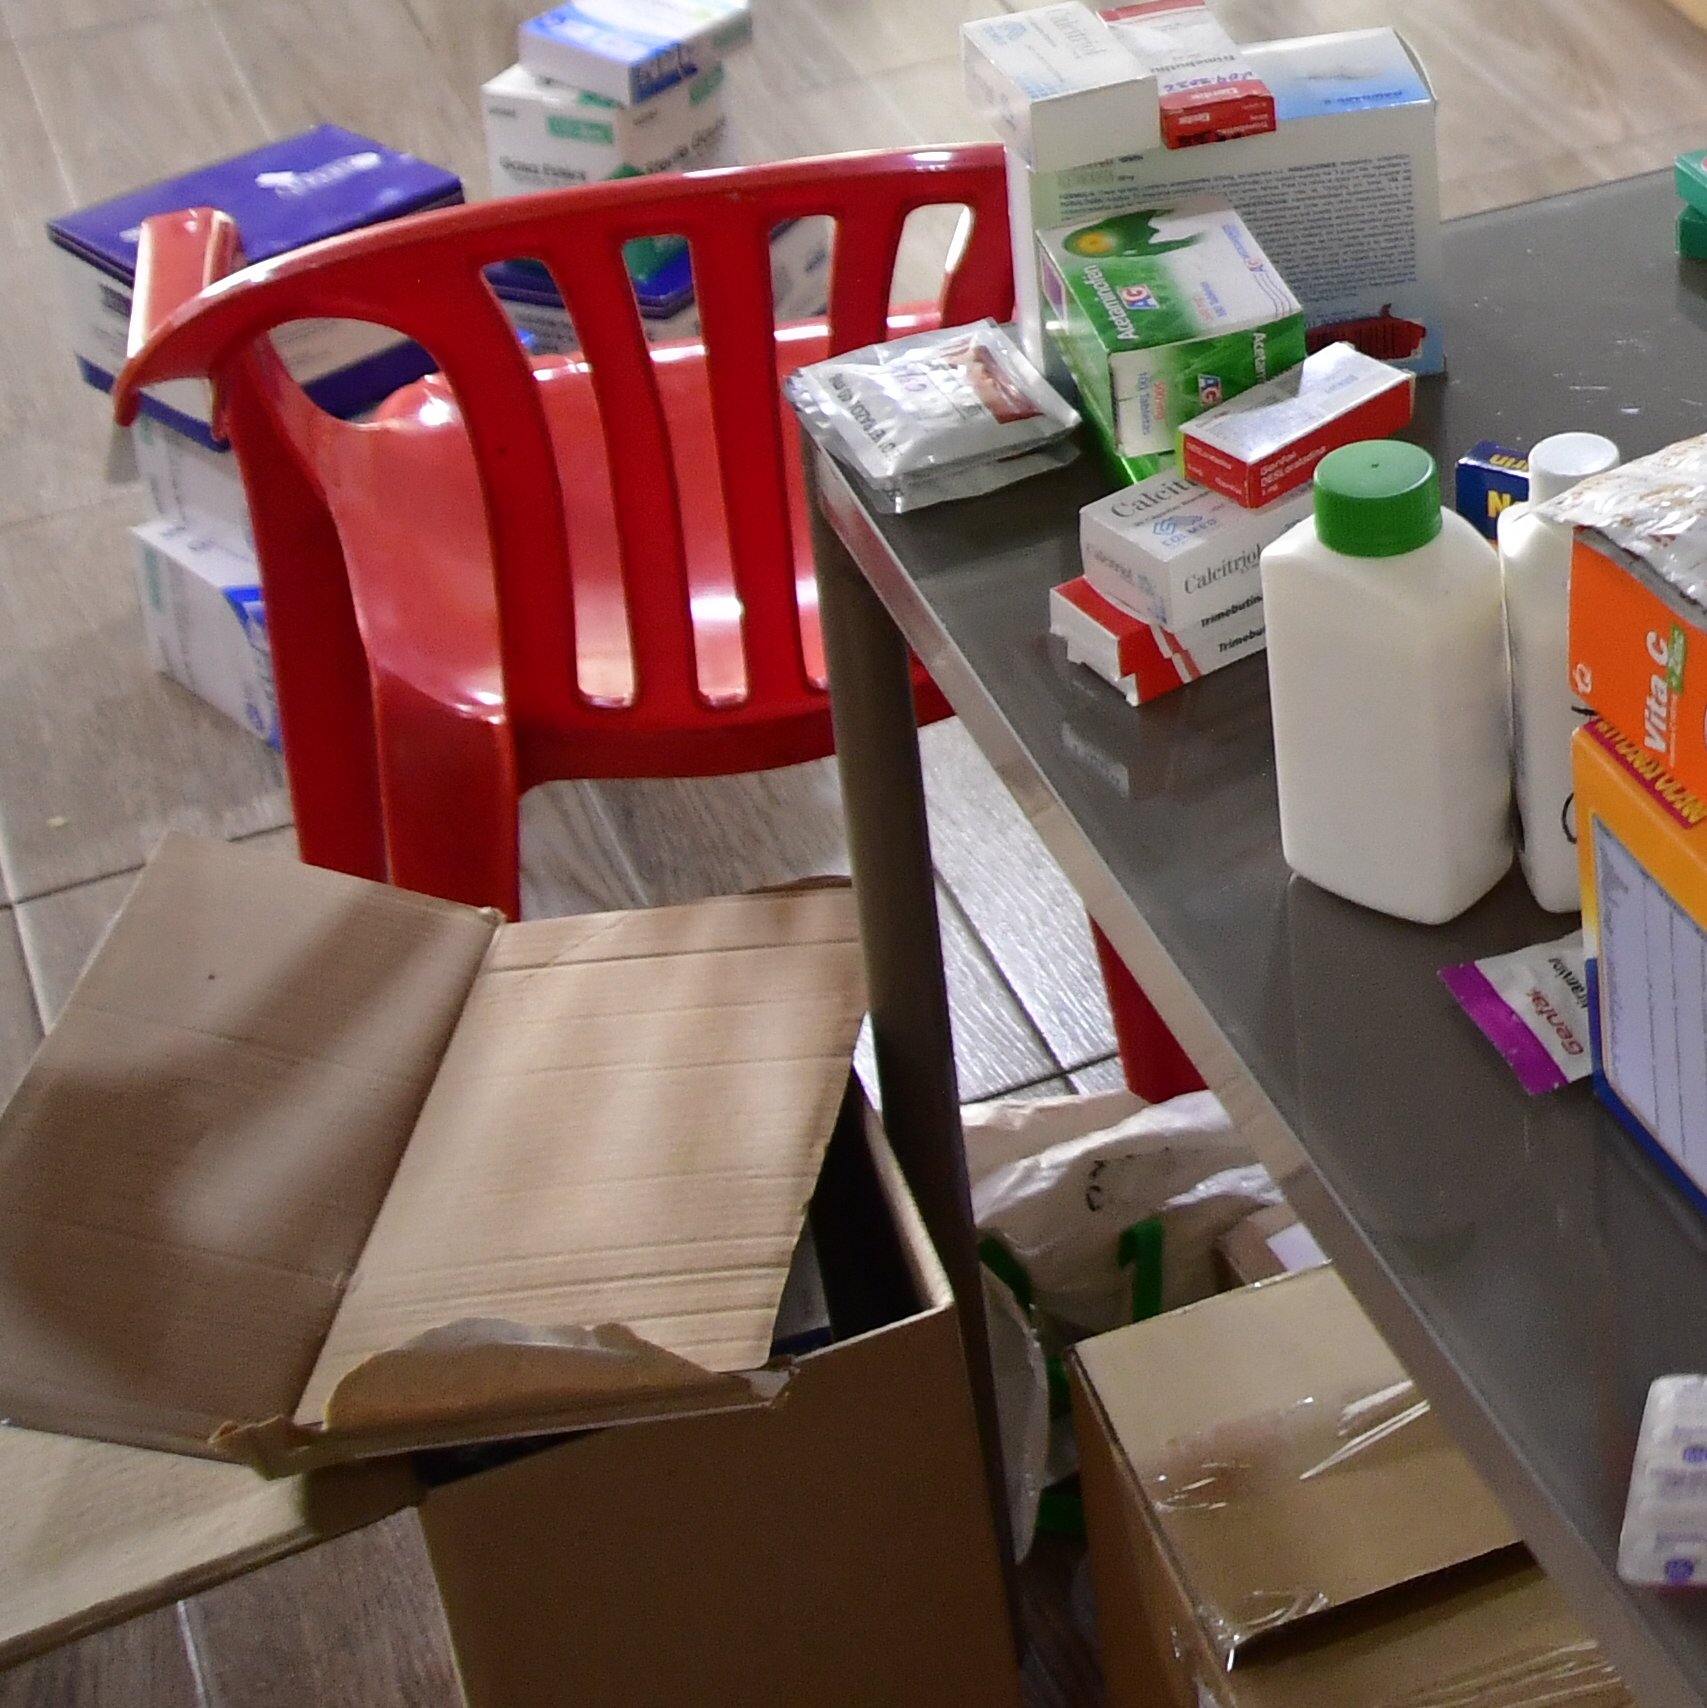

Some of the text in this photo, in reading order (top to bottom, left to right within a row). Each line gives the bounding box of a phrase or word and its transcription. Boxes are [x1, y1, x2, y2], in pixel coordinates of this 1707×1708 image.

[1083, 262, 1140, 341] Acetaminofén
[1183, 542, 1263, 596] Calcitriol
[1644, 630, 1670, 754] Vita C
